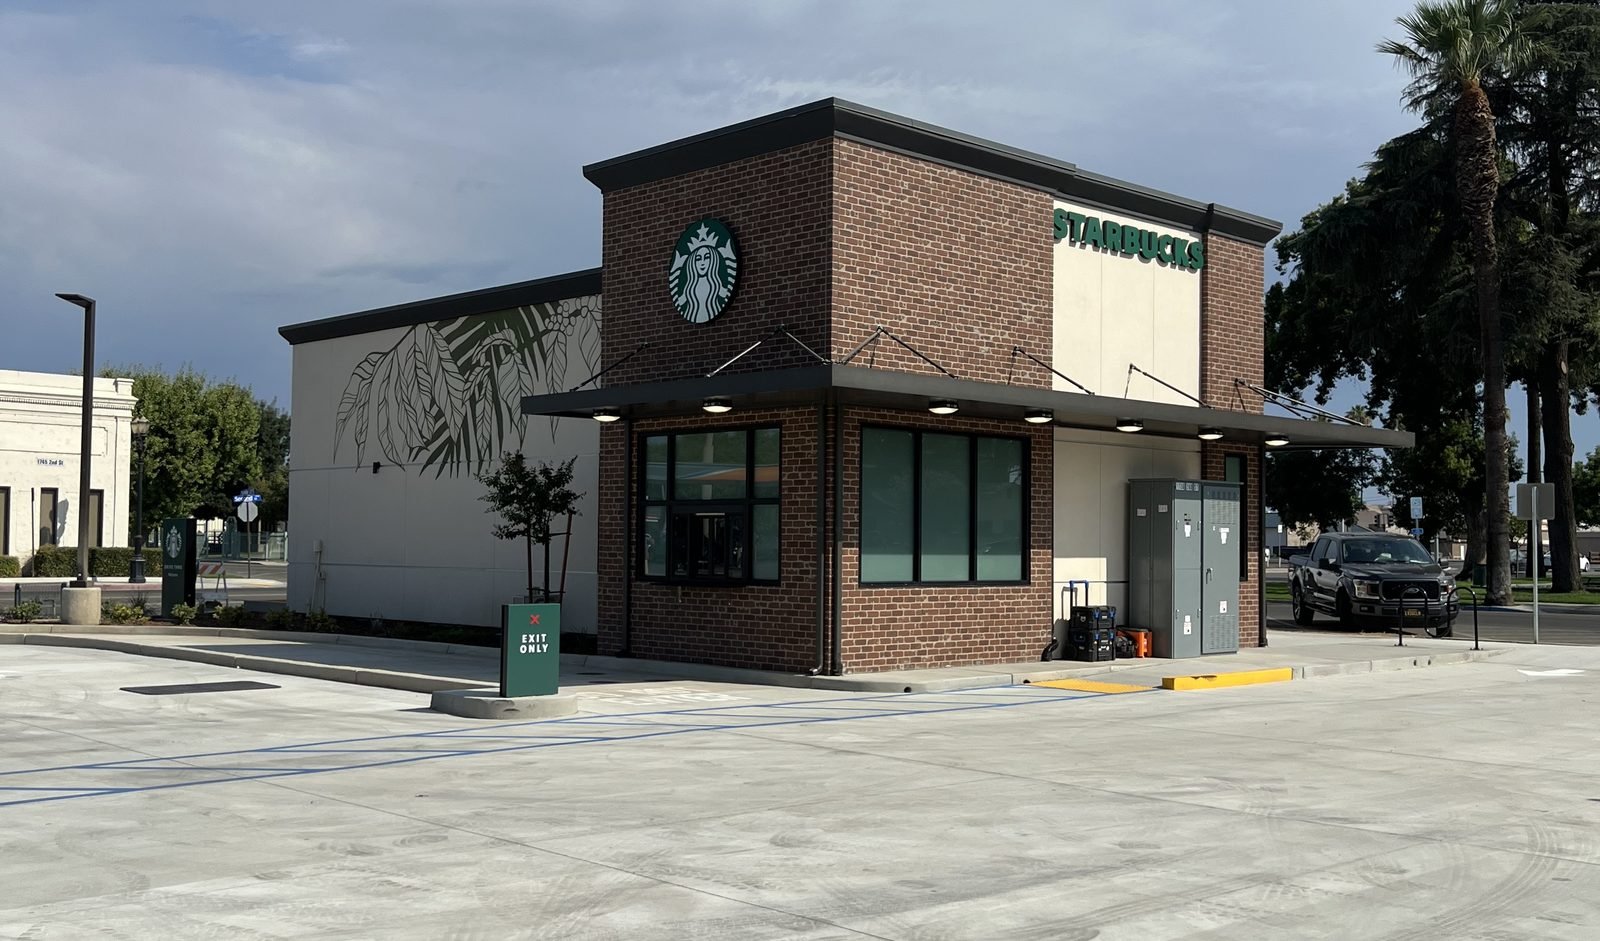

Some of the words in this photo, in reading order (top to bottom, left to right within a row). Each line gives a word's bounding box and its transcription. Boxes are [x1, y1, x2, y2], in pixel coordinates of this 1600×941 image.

[1053, 208, 1204, 270] STARBUCKS
[521, 633, 547, 643] EXIT
[519, 643, 549, 654] ONLY
